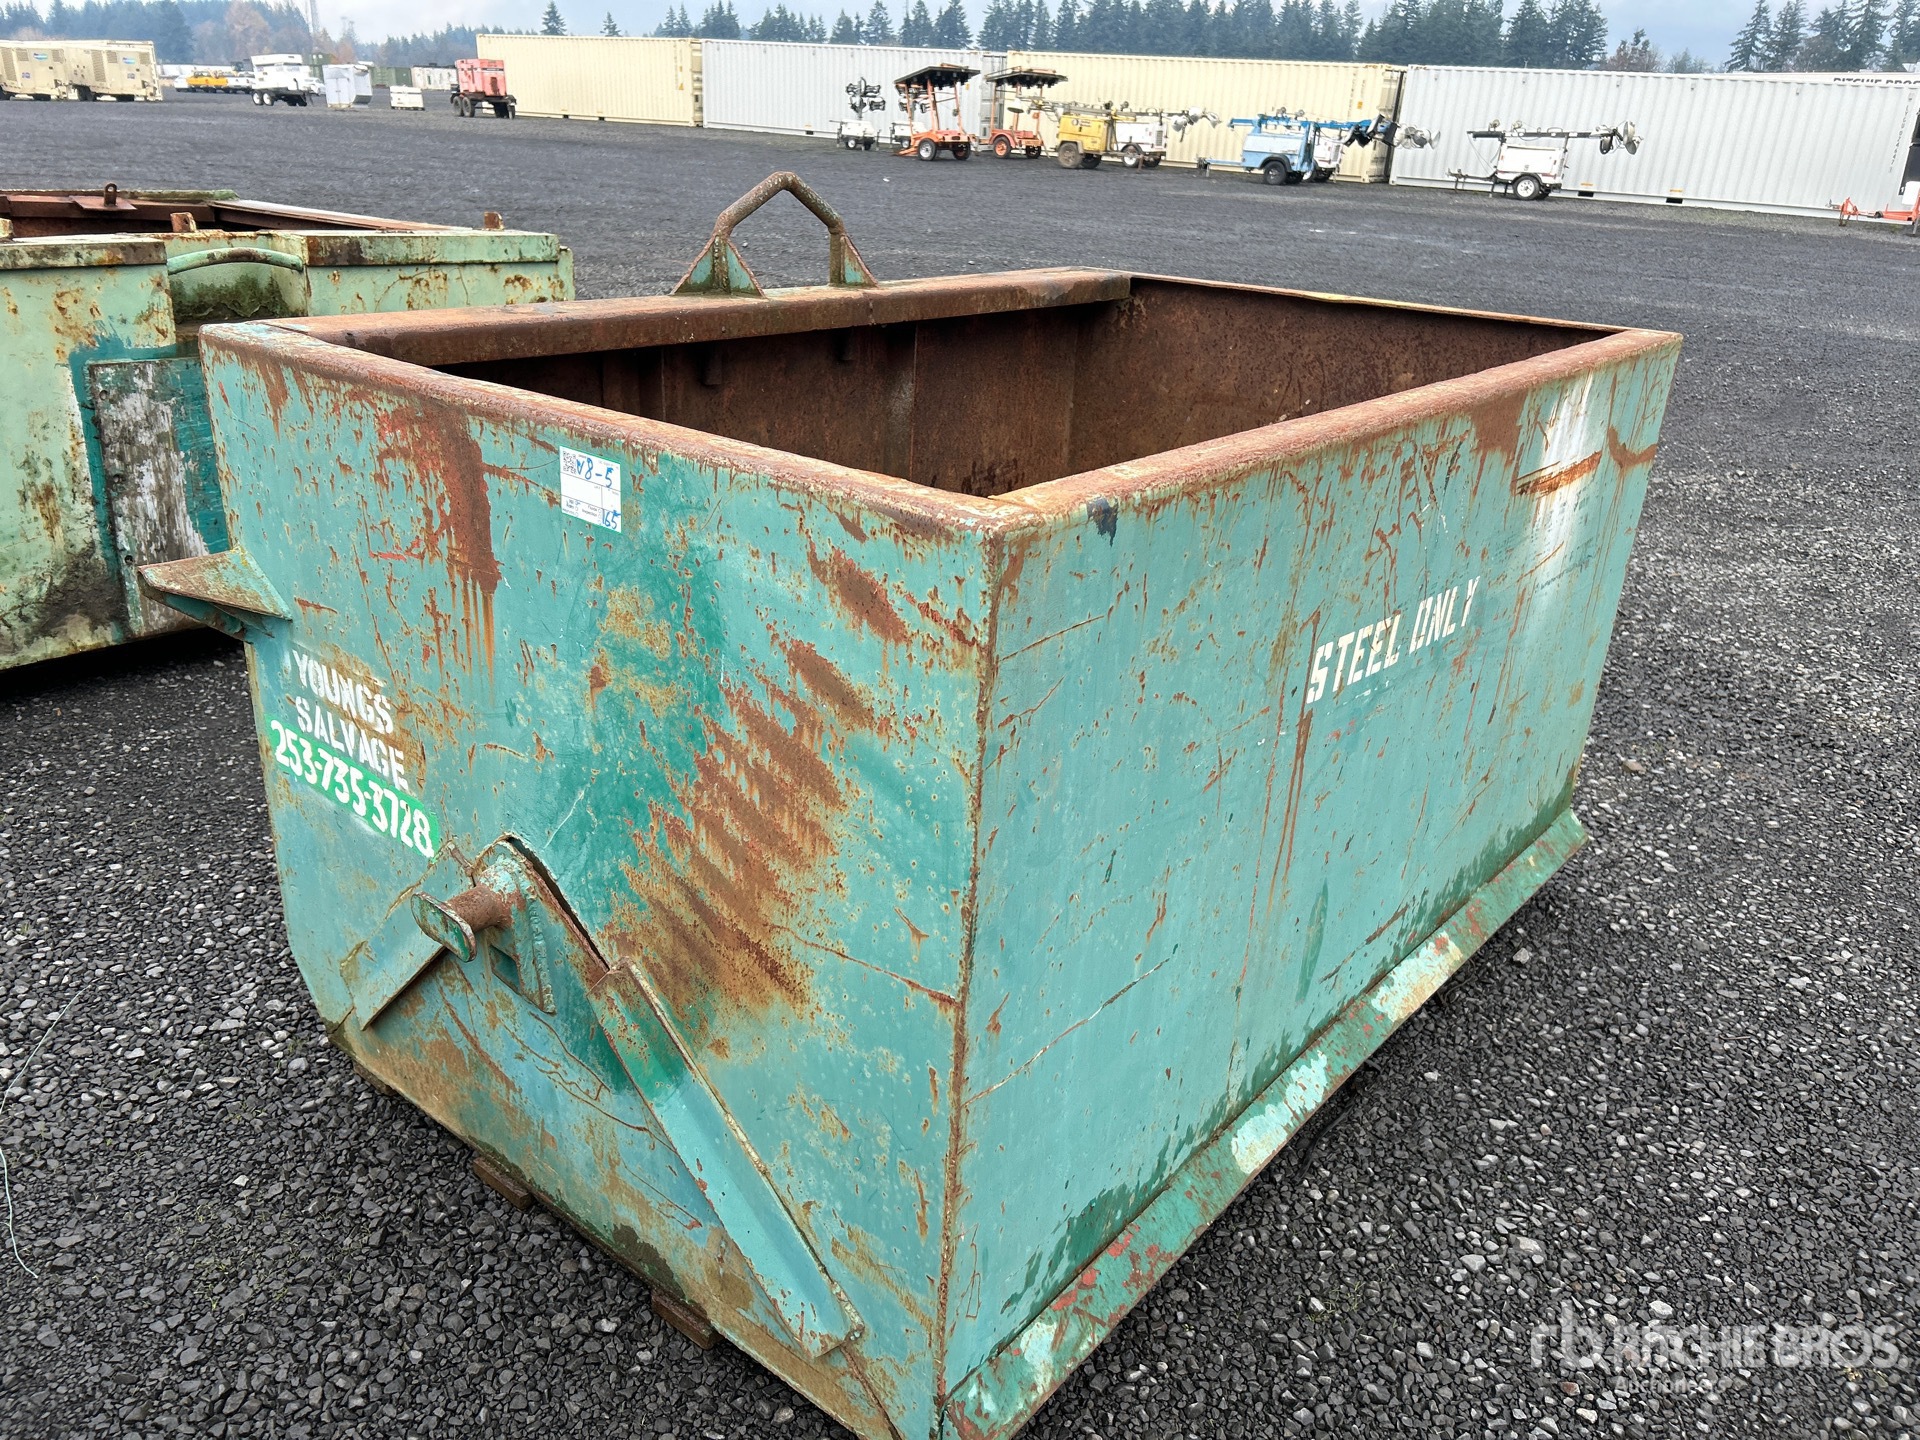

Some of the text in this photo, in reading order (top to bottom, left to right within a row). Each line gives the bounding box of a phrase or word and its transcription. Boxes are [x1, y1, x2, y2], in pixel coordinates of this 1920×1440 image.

[602, 509, 621, 530] 165
[1306, 576, 1480, 704] STEEL ONLY
[292, 649, 394, 735] YOUNGS
[270, 719, 435, 858] 253-735-3728
[295, 696, 409, 791] SALVAGE
